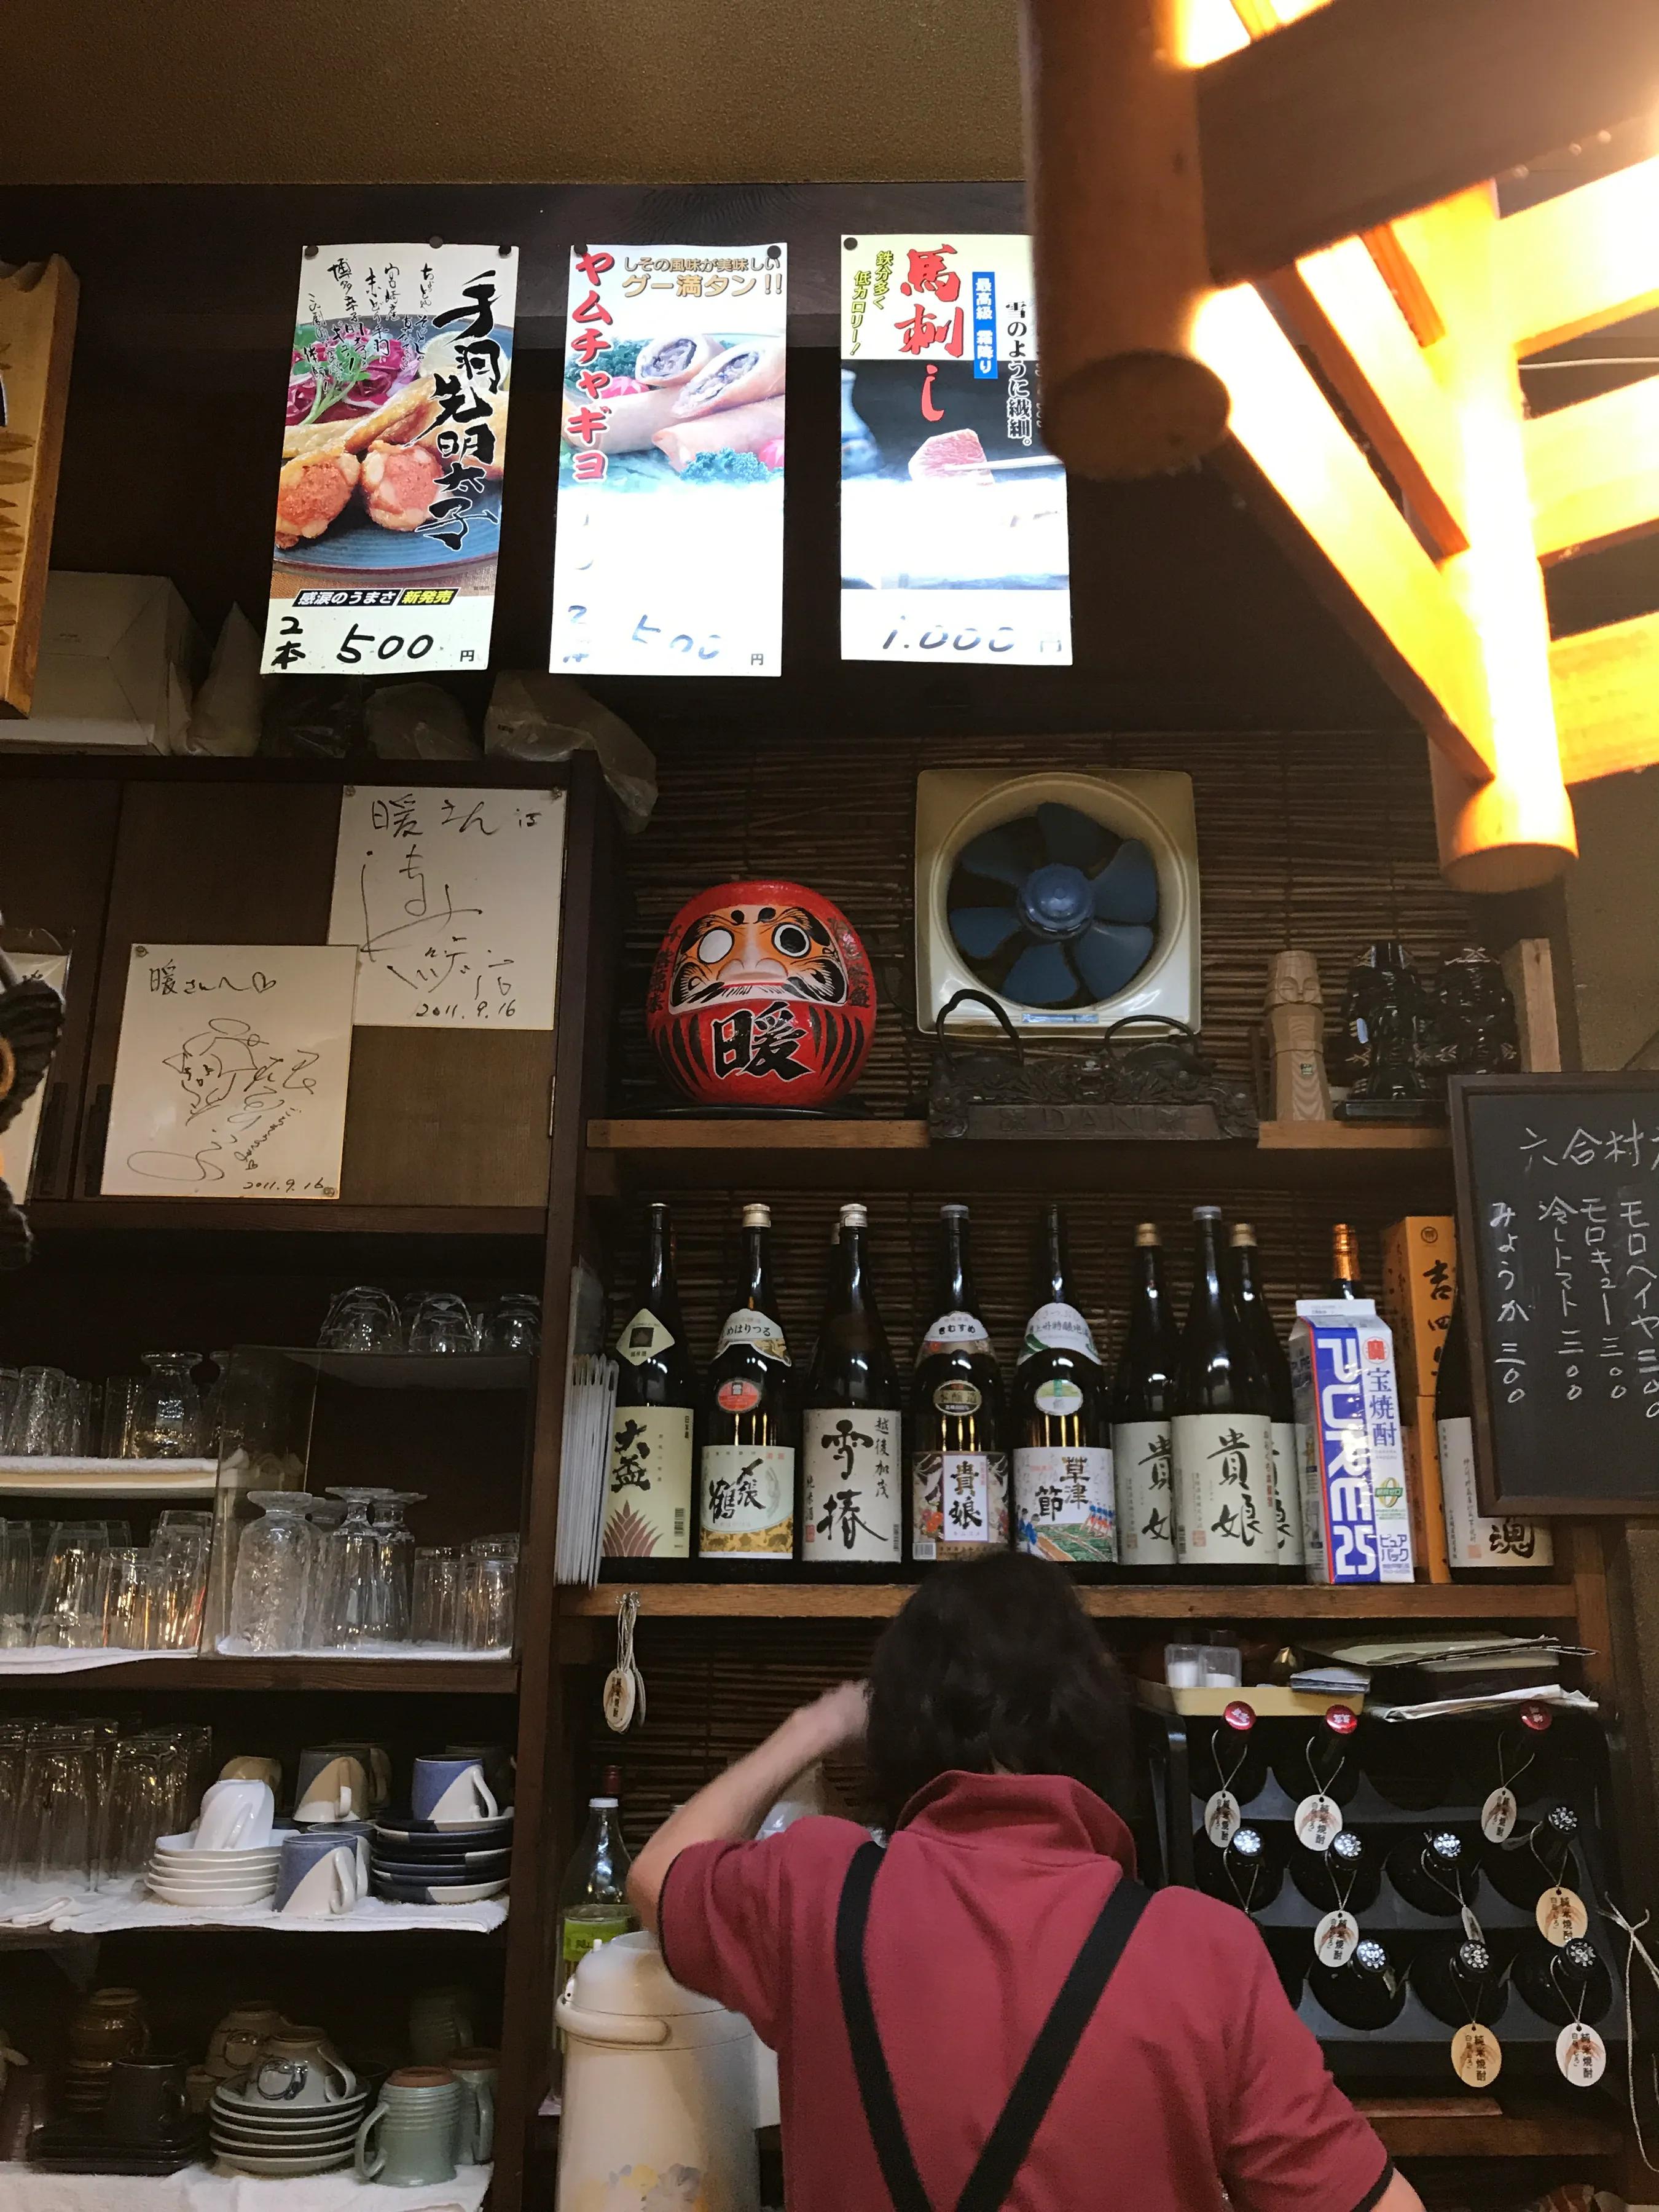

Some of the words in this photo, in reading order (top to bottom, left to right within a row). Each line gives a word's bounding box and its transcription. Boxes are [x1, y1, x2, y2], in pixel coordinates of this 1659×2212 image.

[874, 251, 893, 309] 鉄分多く
[893, 244, 963, 422] 馬刺し
[402, 270, 500, 551] 手羽先明太子
[297, 589, 397, 606] 感涙のうまさ
[401, 589, 455, 606] 新発売
[337, 624, 434, 664] 500
[459, 651, 474, 662] 円
[751, 653, 764, 665] 円
[711, 1000, 815, 1082] 暖
[1520, 1118, 1659, 1172] 六合村
[1490, 1201, 1534, 1322] みょうが
[1422, 1259, 1453, 1376] 吉四
[1318, 1338, 1373, 1522] PURE
[1367, 1367, 1397, 1446] 宝焼酎
[874, 1416, 890, 1499] 越後加茂
[1207, 1427, 1263, 1547] 貴娘
[1380, 1534, 1407, 1548] ピュア
[1381, 1548, 1409, 1562] パック
